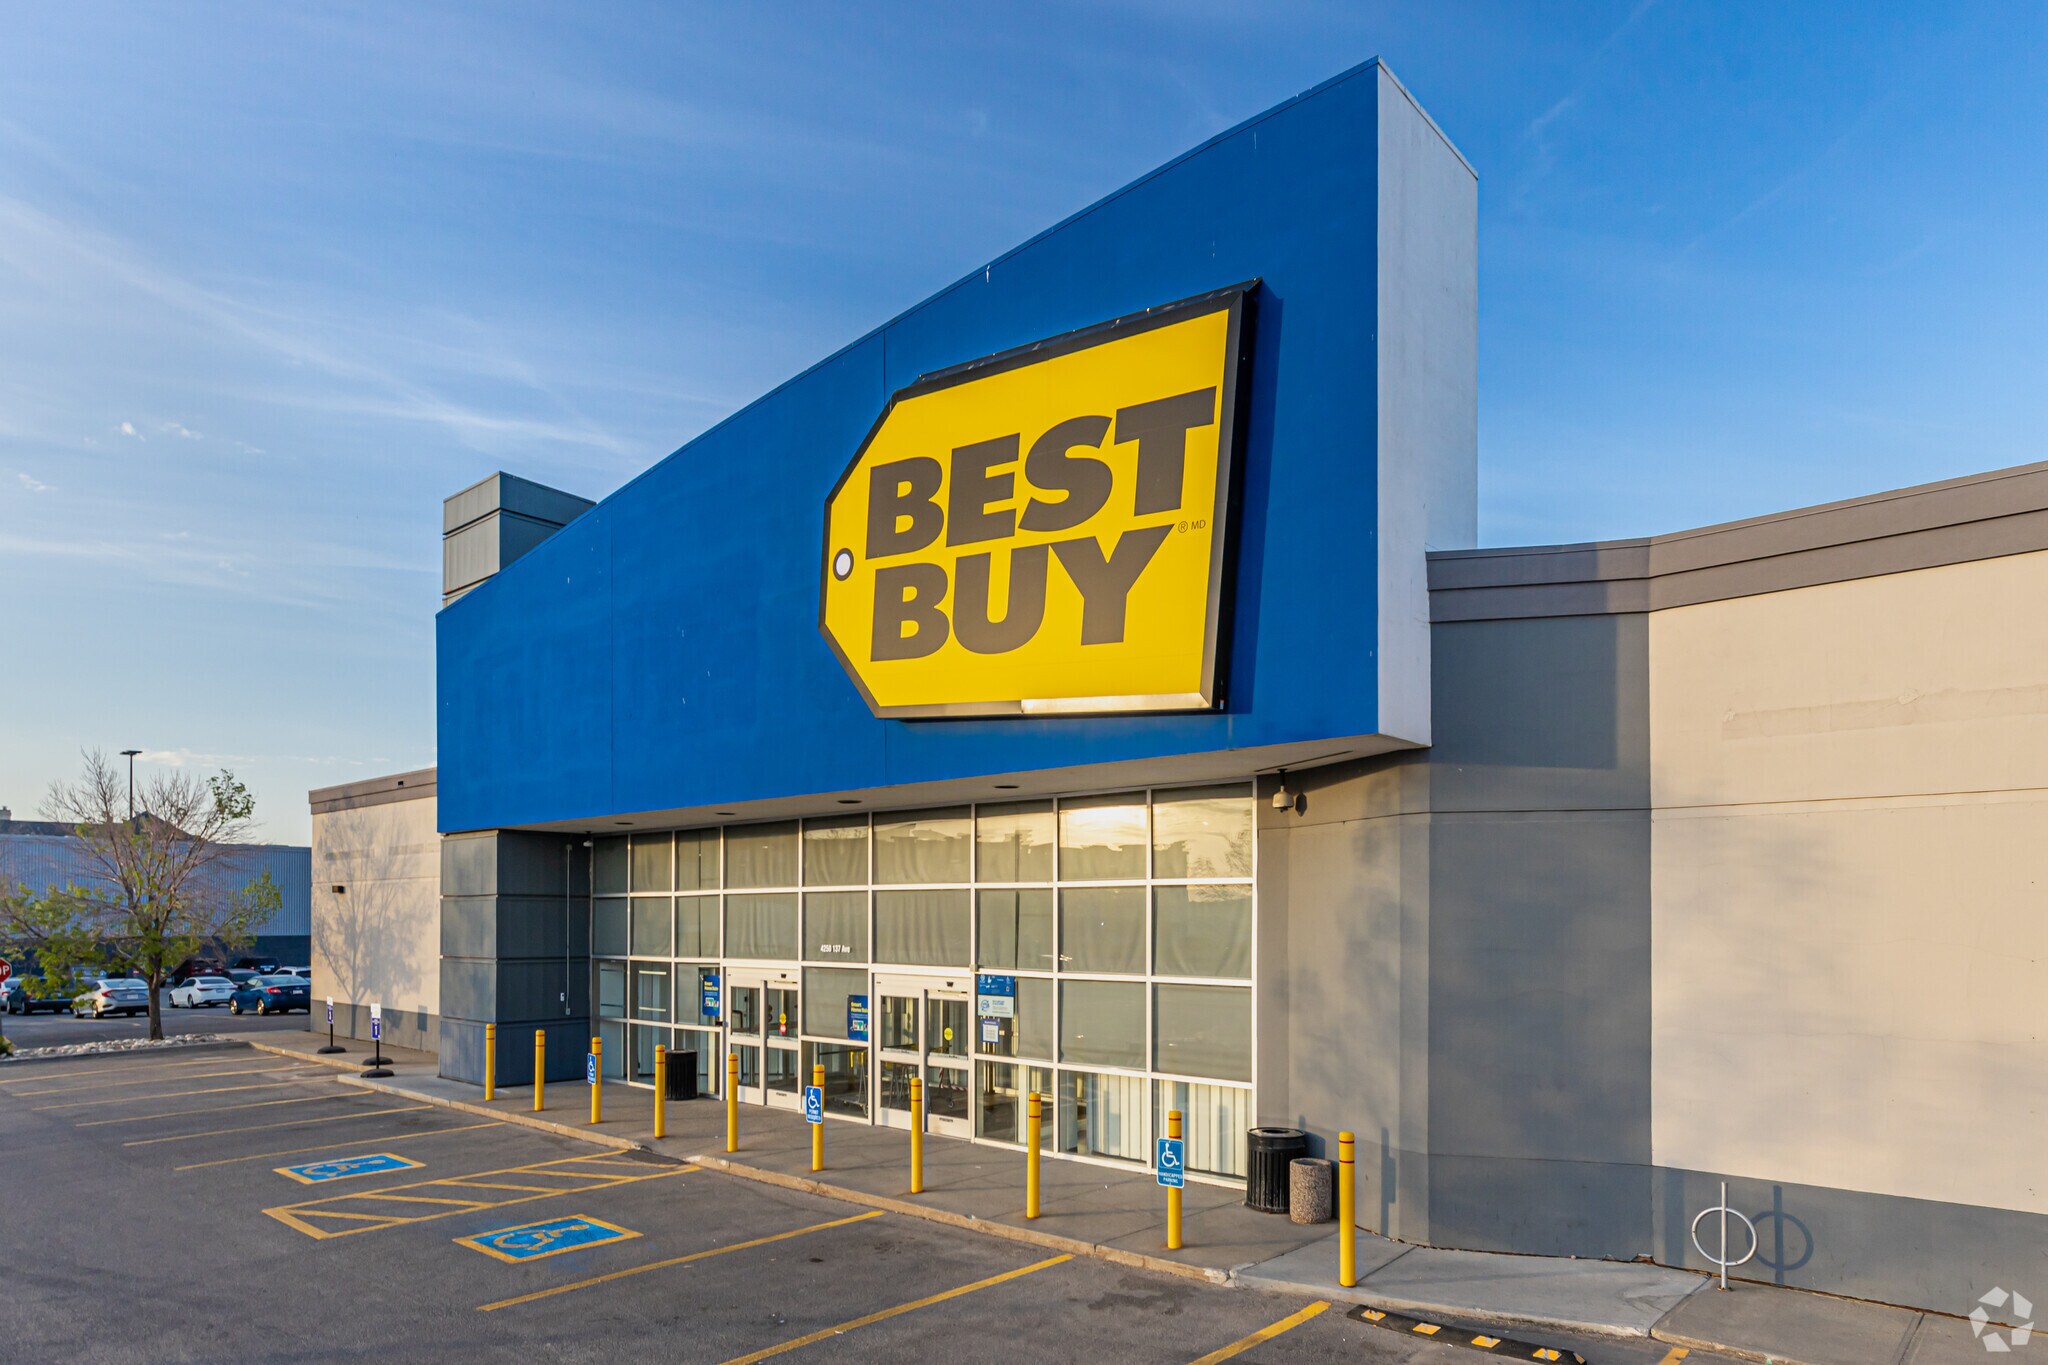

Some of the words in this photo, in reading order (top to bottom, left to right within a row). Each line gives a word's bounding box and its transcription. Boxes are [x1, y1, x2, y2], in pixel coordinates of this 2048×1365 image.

[866, 386, 1217, 560] BEST
[1191, 519, 1206, 530] MD
[871, 523, 1175, 662] BUY
